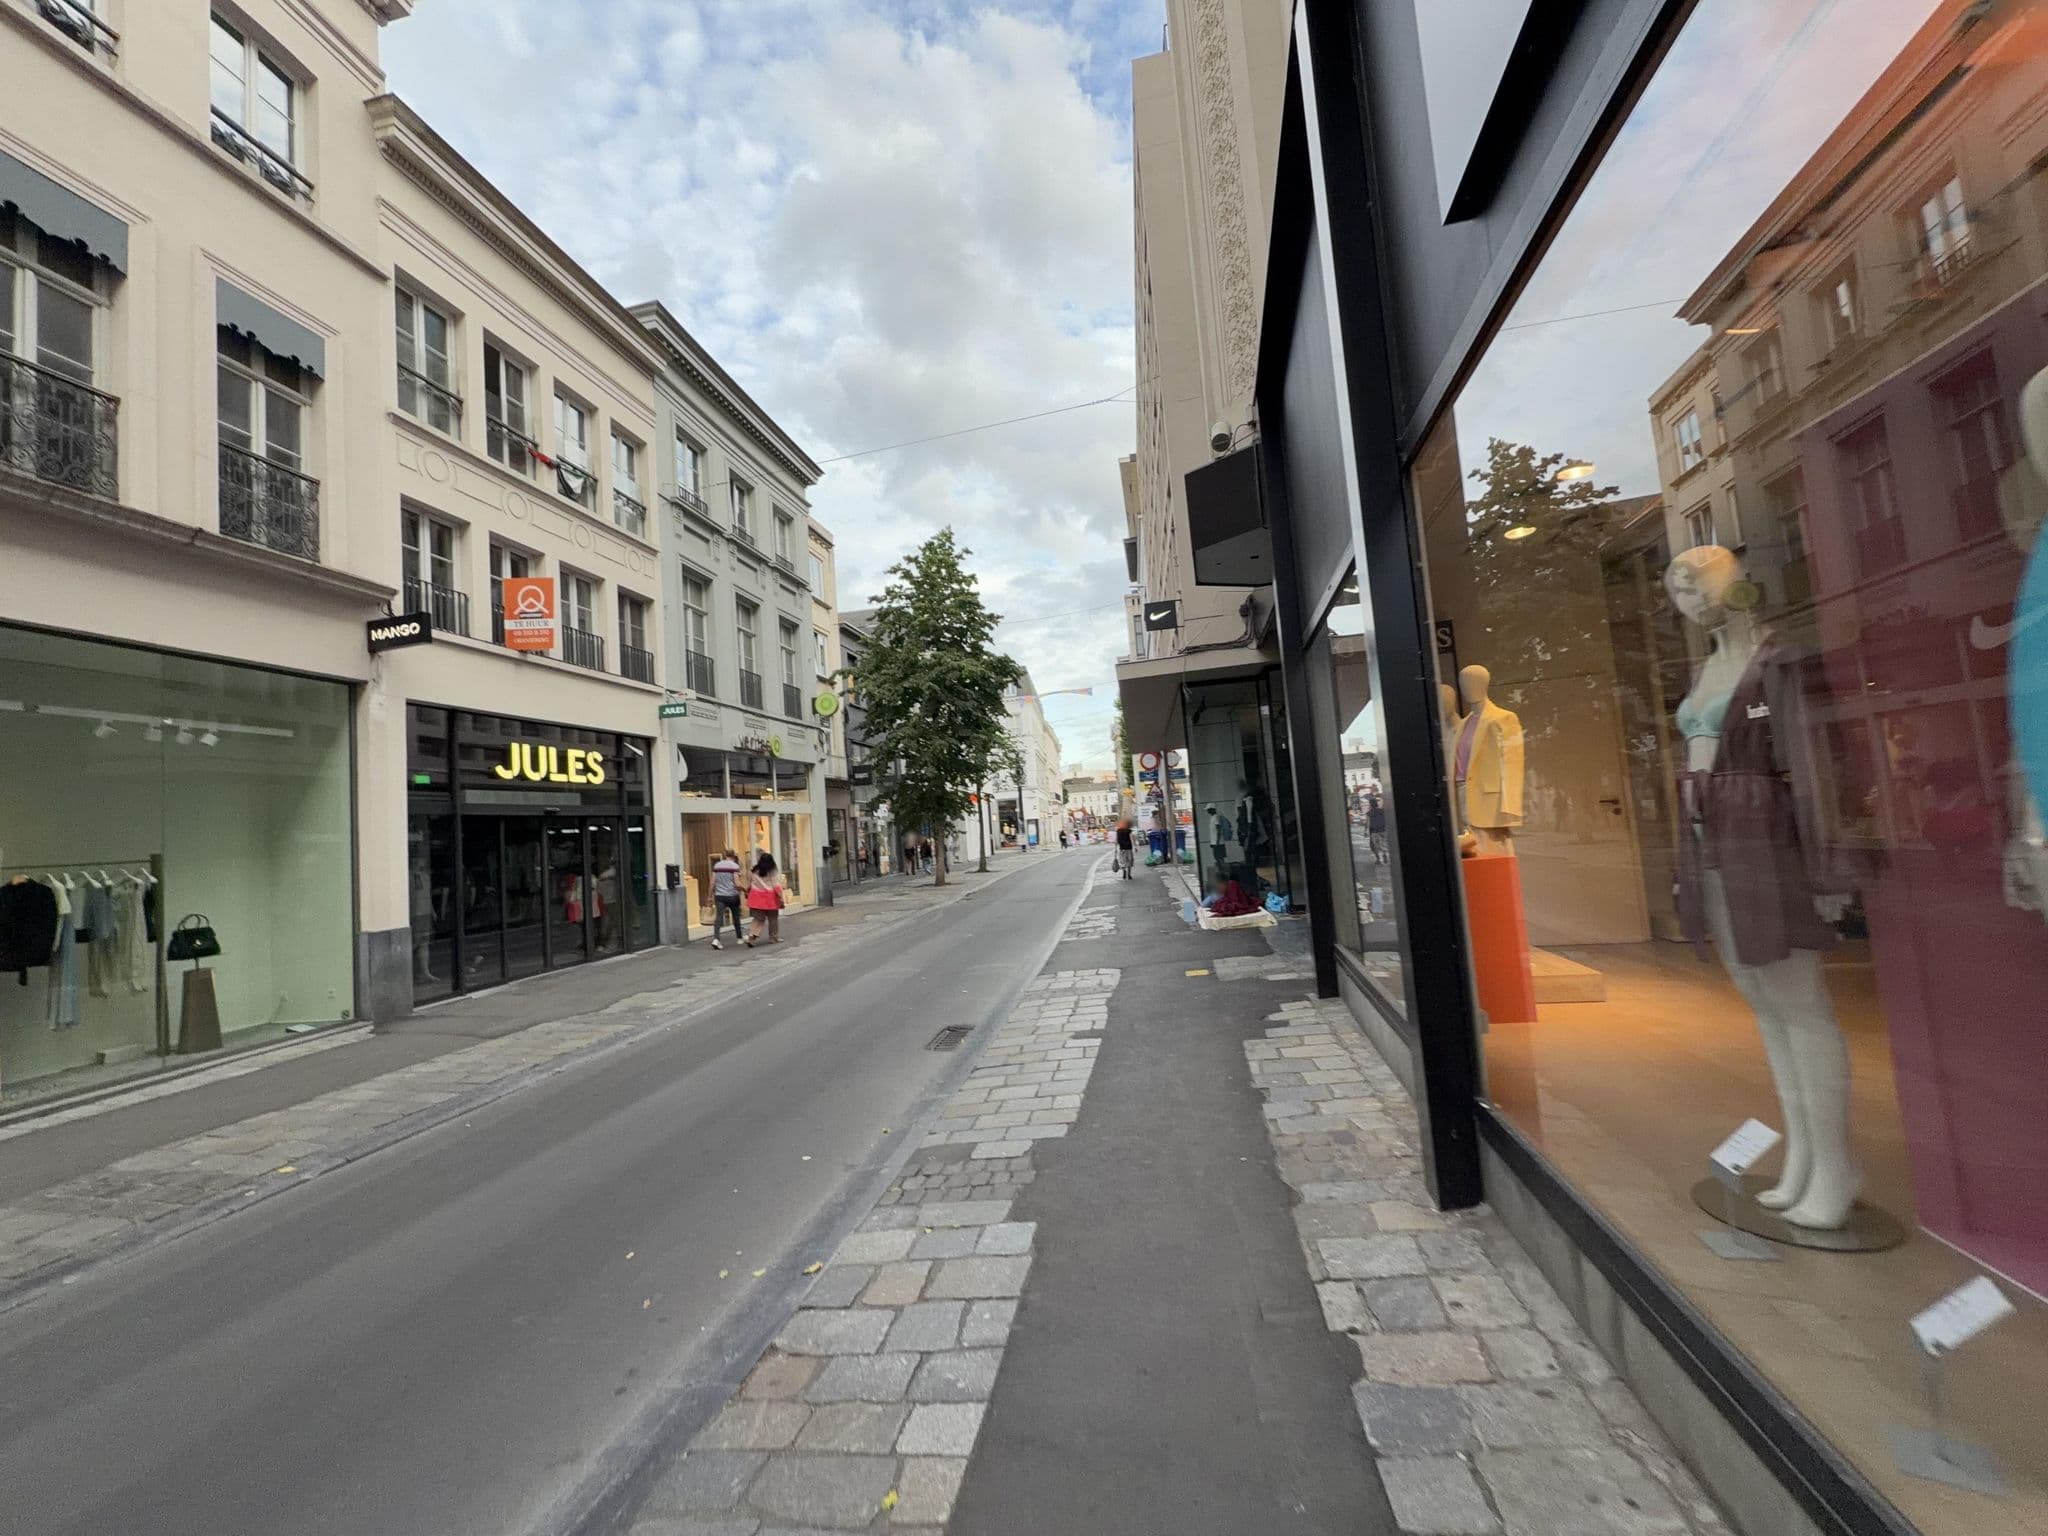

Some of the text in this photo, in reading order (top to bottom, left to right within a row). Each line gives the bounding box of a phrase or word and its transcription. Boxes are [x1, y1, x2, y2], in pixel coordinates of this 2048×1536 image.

[526, 620, 550, 628] HUUR
[371, 622, 421, 642] MANGO
[662, 706, 686, 715] JULES
[494, 742, 606, 785] JULES
